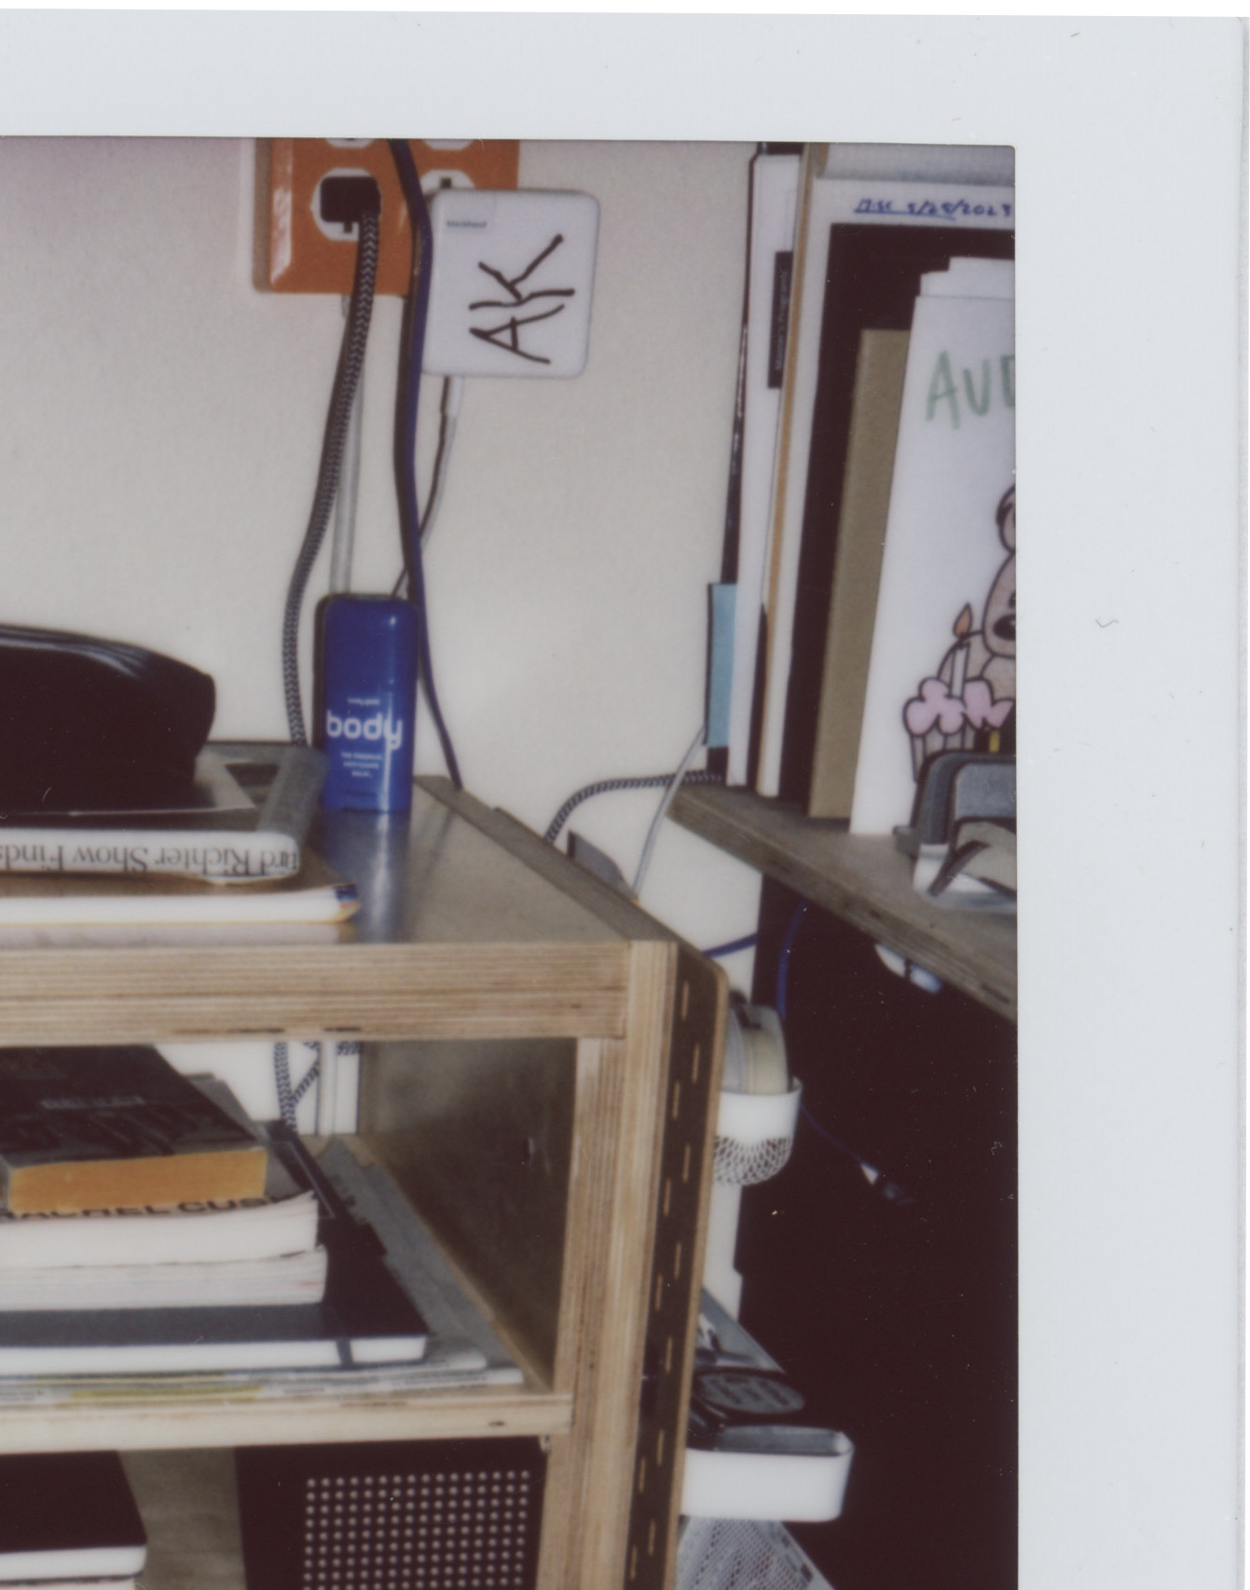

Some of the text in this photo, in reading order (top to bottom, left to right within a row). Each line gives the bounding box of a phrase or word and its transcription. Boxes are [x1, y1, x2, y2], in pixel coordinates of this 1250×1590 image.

[468, 233, 576, 365] AK
[325, 709, 404, 751] body
[72, 844, 148, 873] Show
[155, 846, 249, 876] Richter
